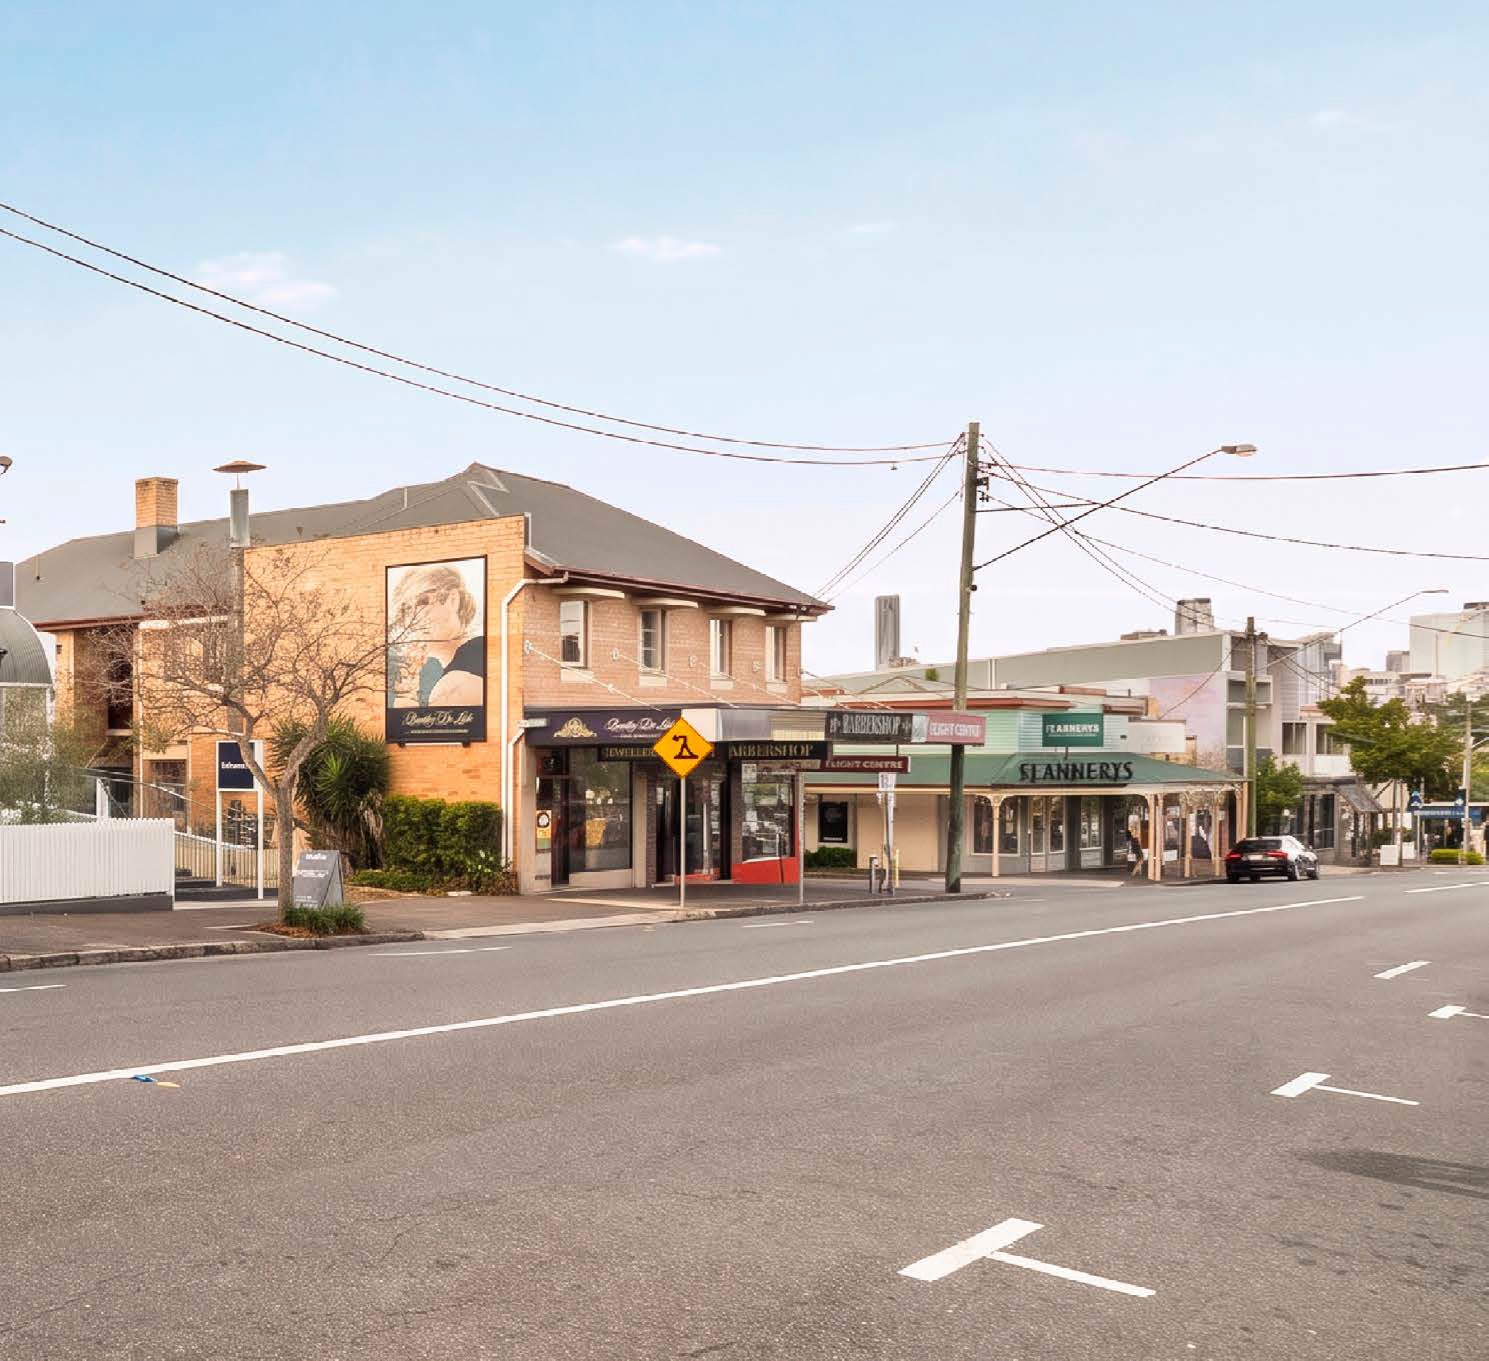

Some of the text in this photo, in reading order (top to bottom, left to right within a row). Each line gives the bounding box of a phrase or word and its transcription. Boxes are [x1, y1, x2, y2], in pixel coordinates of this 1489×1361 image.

[841, 714, 902, 736] BARBERSHOP
[728, 743, 813, 757] ARBERSHOP
[825, 759, 903, 769] FLIGHT CENTRE
